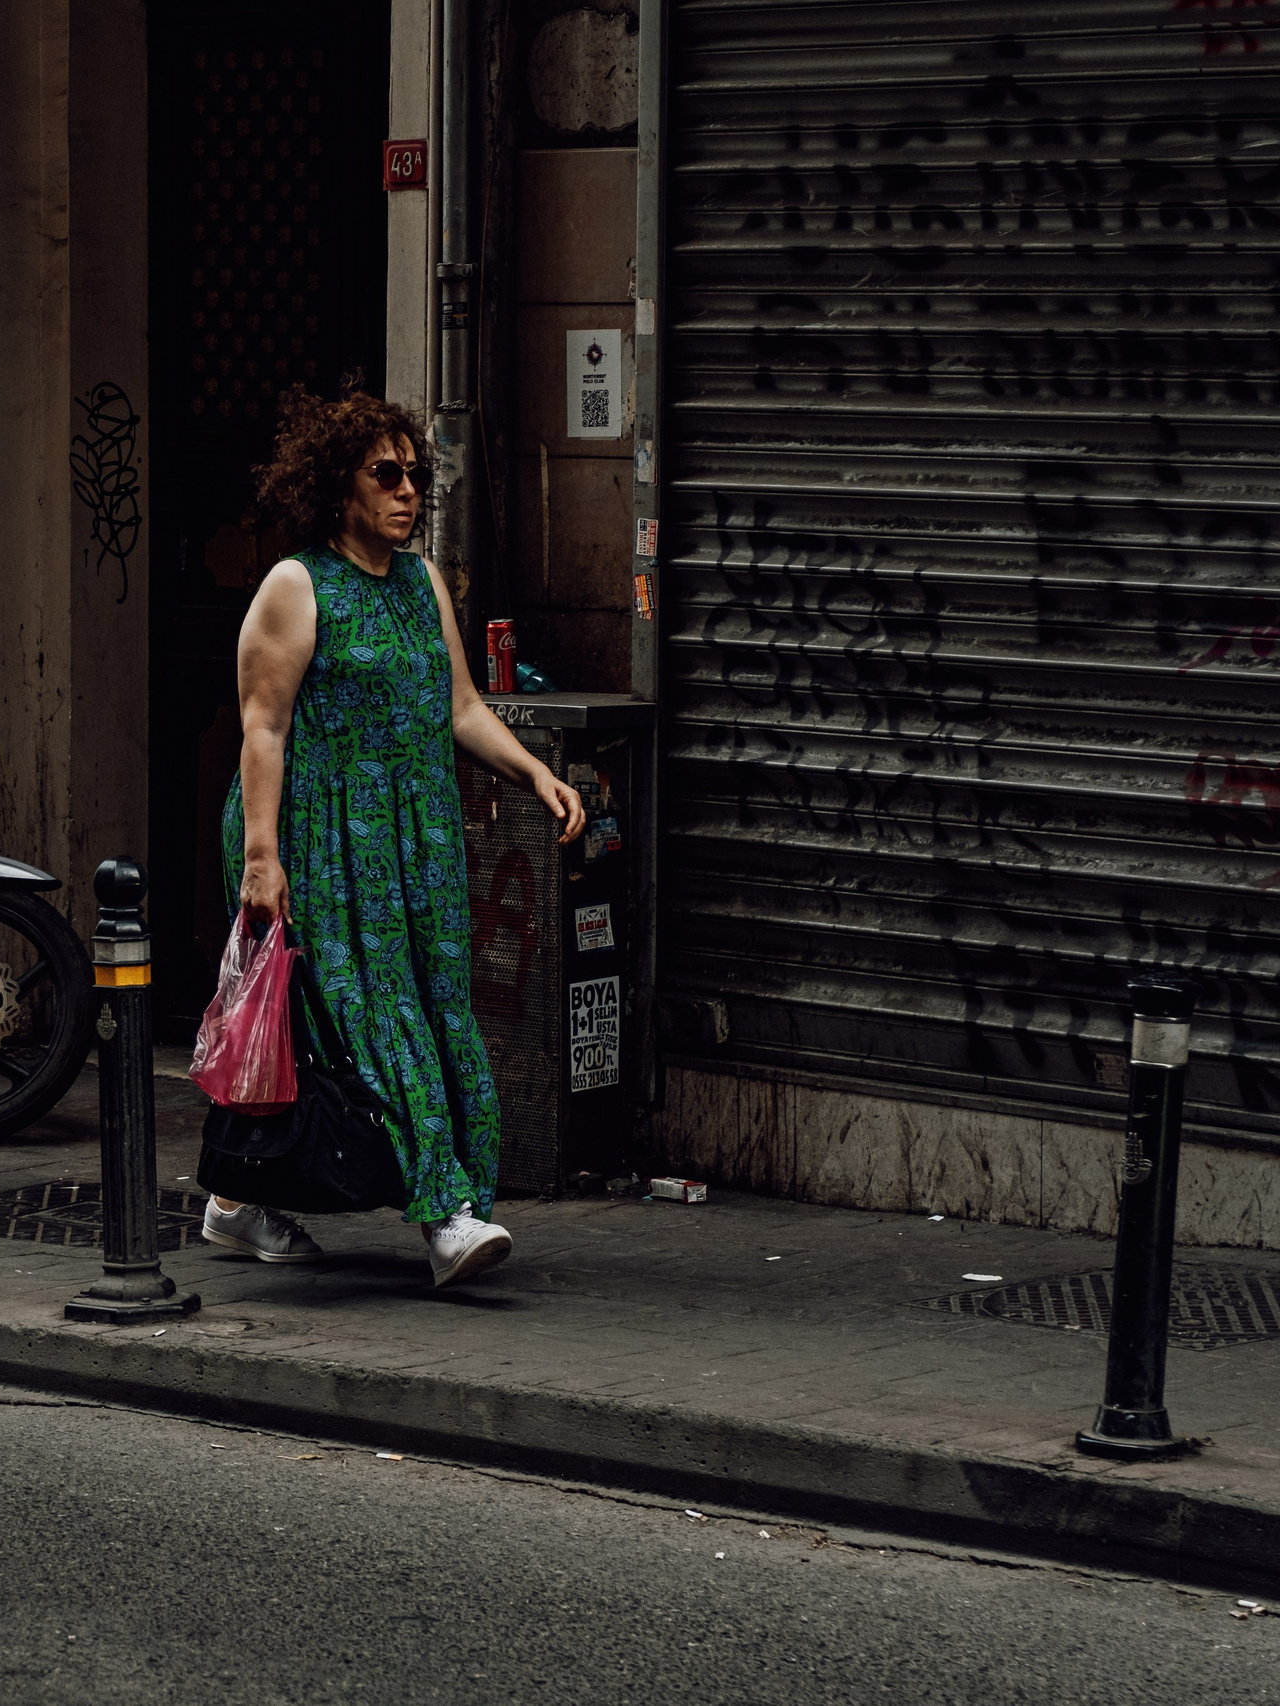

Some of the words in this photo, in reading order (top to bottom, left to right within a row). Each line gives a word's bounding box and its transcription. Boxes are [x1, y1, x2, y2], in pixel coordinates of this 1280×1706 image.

[571, 981, 617, 1010] BOYA
[572, 1008, 594, 1036] 1+1
[597, 1020, 617, 1034] USTA
[572, 1036, 588, 1045] BOYA
[573, 1045, 605, 1073] 900
